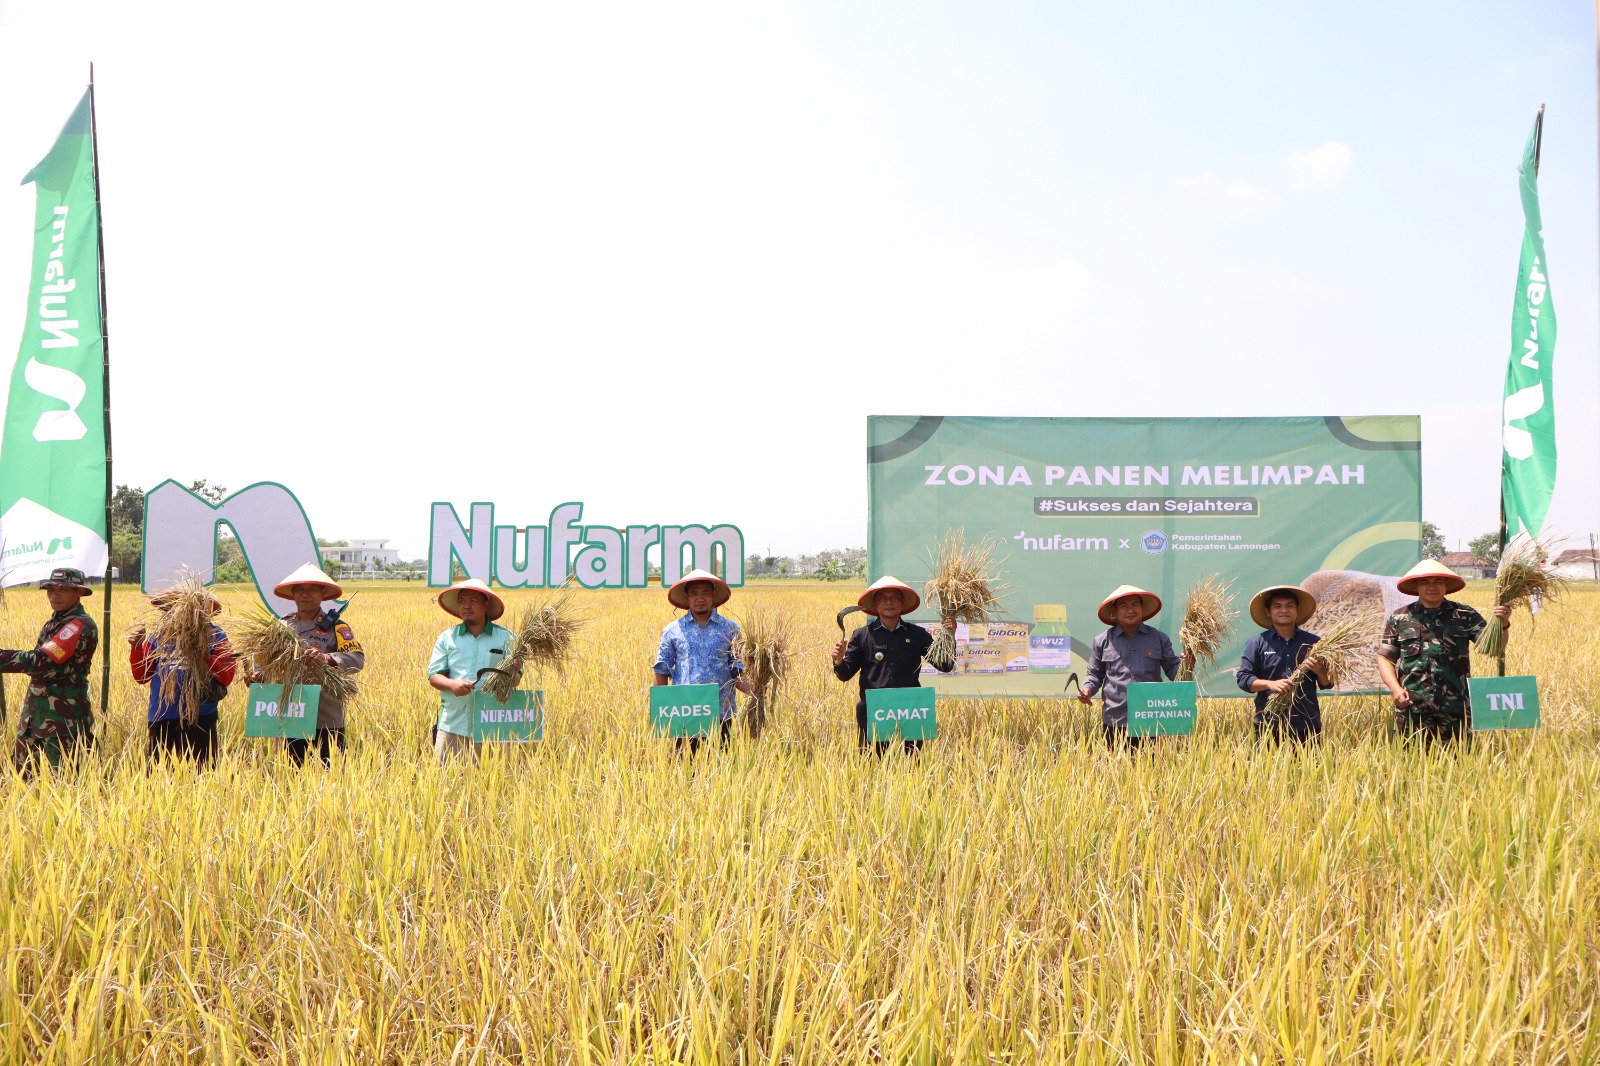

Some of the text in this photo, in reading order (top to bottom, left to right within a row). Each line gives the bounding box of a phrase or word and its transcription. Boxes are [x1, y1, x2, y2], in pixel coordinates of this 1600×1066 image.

[924, 465, 1365, 486] ZONA PANEN MELIMPAH
[1039, 499, 1253, 514] #Sukses dan Sejahtera
[428, 501, 745, 589] Nufarm
[1022, 534, 1109, 550] nufarm
[1171, 543, 1281, 551] Kabupaten Lamongan
[309, 635, 329, 643] POLRI
[1041, 637, 1065, 645] WUZ
[1147, 699, 1178, 708] DINAS
[1486, 692, 1525, 711] TNI
[254, 701, 306, 718] PORI
[480, 708, 535, 723] NUFARM
[658, 704, 712, 718] KADES
[874, 707, 930, 721] CAMAT
[1134, 710, 1191, 719] PERTANIAN
